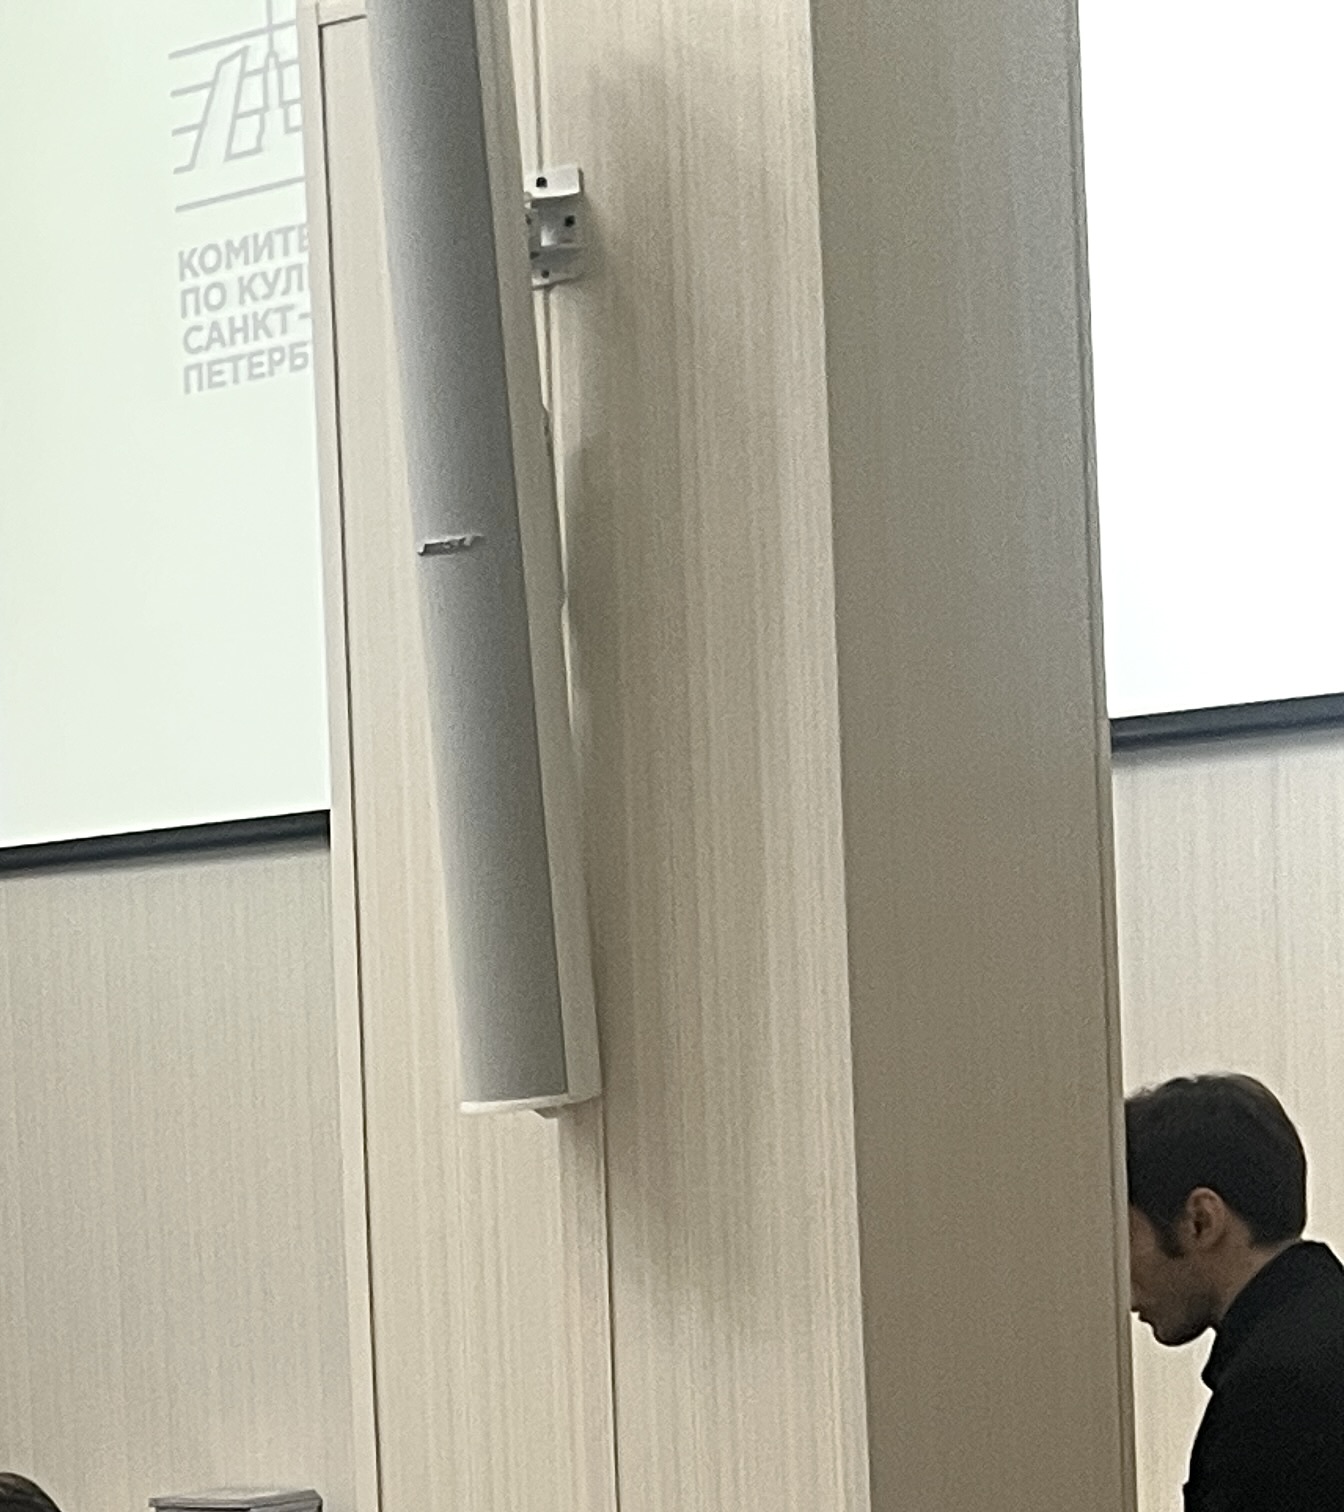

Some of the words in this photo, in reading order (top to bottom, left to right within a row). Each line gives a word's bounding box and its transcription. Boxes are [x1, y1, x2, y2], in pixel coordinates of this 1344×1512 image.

[180, 281, 228, 319] ПО
[183, 304, 311, 354] САНКТ-
[183, 341, 310, 395] ПЕТЕРБ
